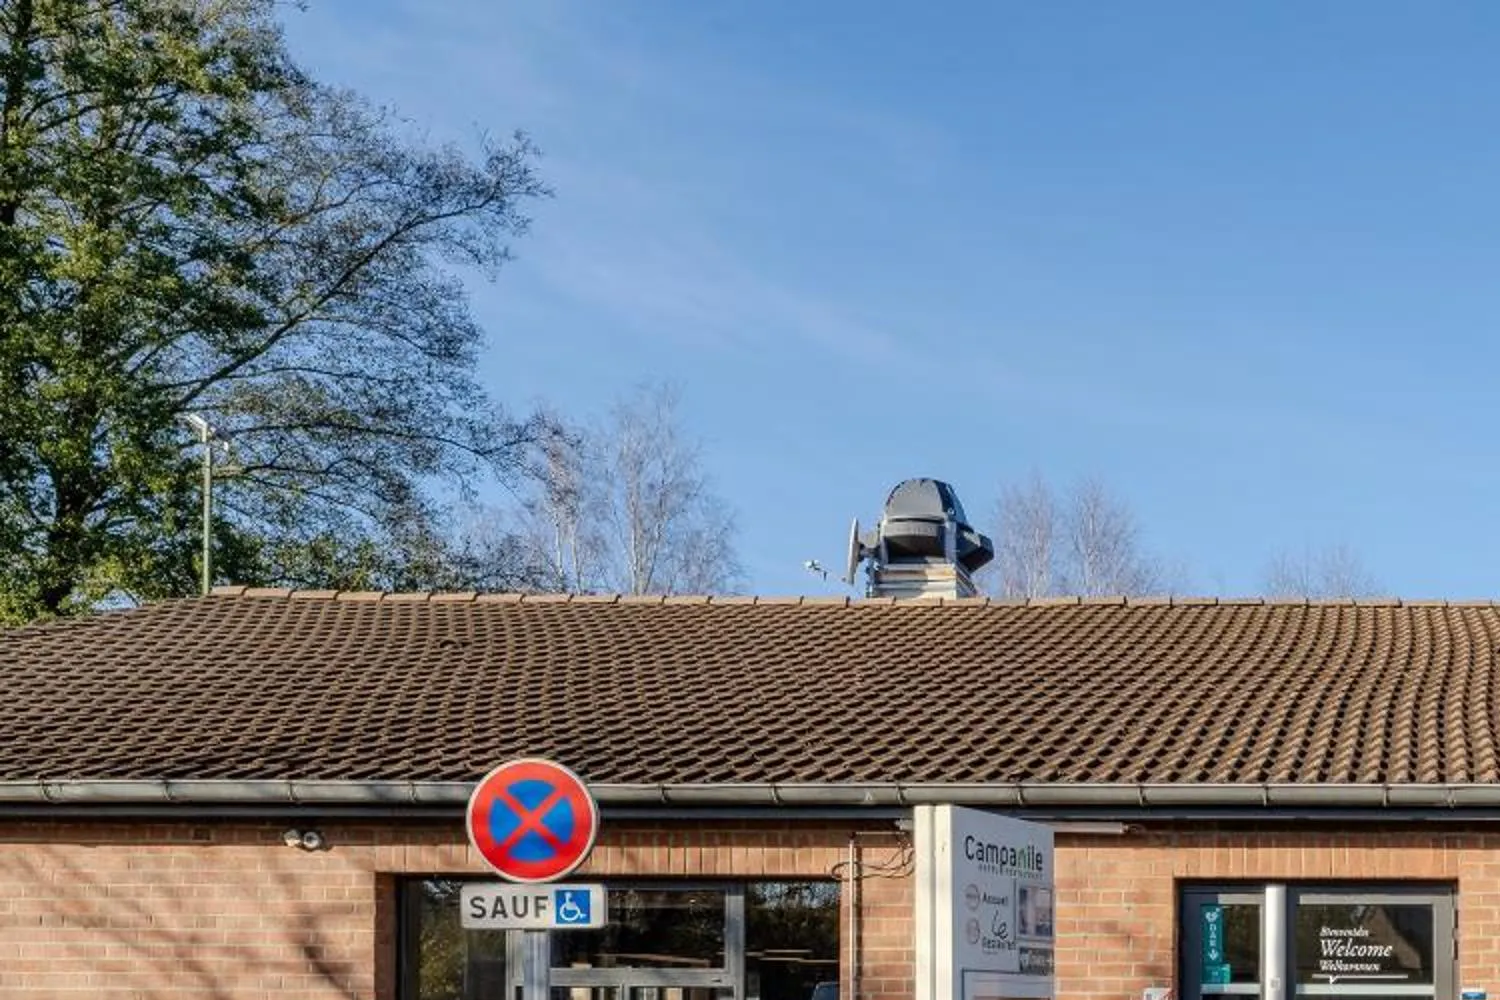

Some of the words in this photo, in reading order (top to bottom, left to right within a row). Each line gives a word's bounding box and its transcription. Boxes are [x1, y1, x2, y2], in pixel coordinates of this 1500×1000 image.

[965, 835, 1043, 872] Campanile
[469, 895, 548, 919] SAUF
[1319, 938, 1393, 957] Welcome
